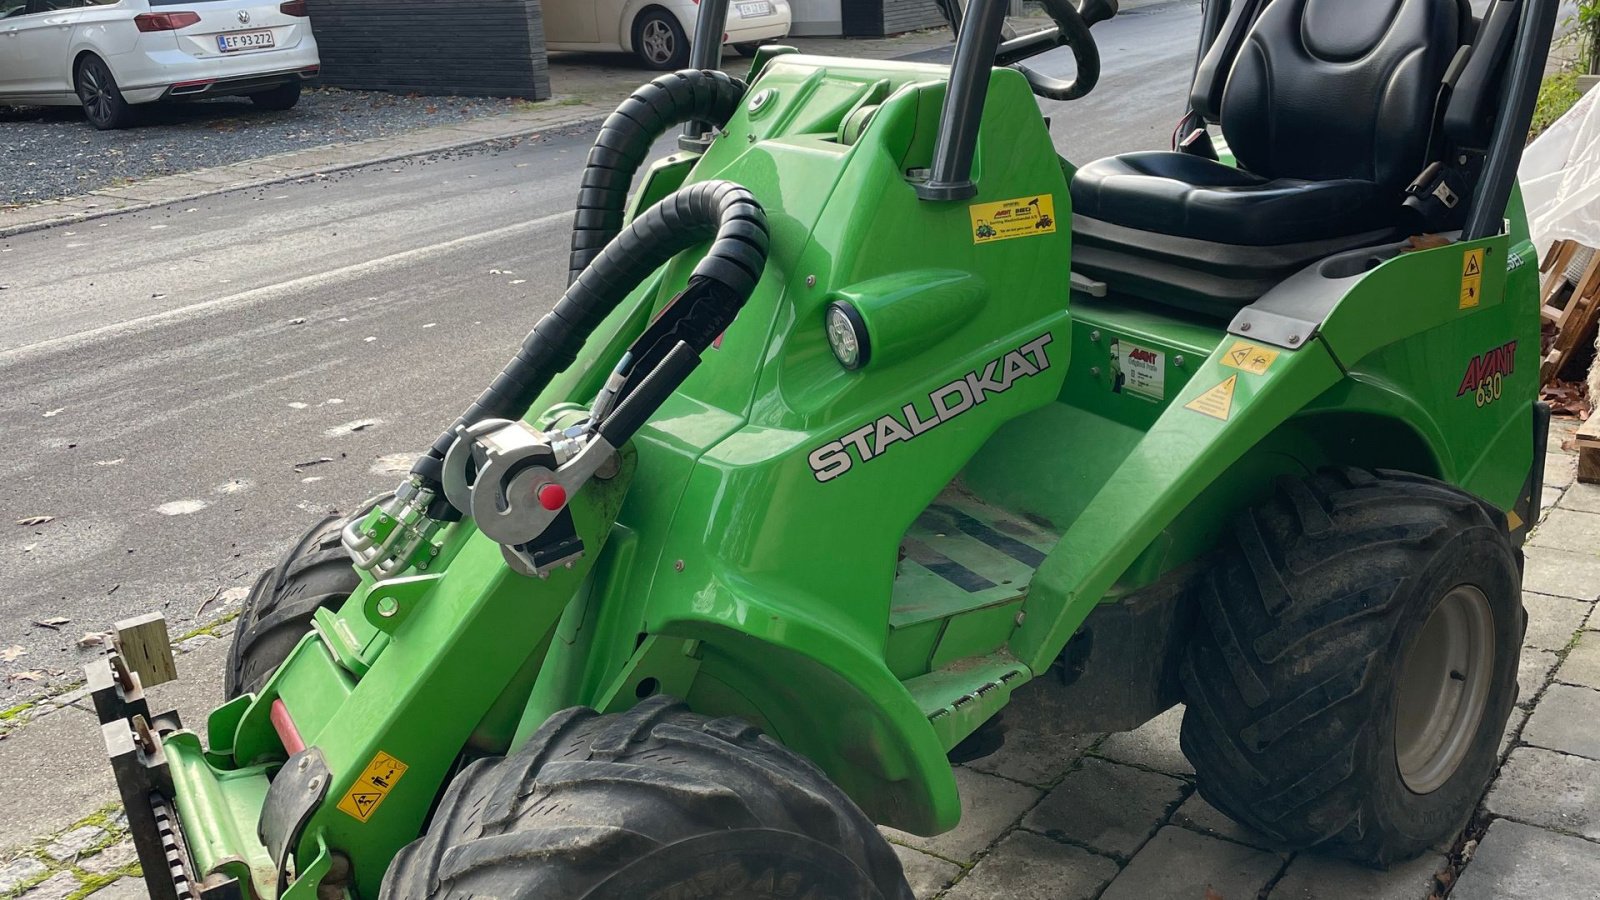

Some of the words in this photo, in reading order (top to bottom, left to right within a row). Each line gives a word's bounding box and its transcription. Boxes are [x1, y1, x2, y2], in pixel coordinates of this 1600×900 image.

[226, 36, 239, 47] EF
[240, 35, 253, 46] 93
[254, 33, 272, 45] 272
[1128, 348, 1158, 365] AVANT
[1456, 340, 1517, 397] AVANT
[808, 332, 1053, 483] STALDKAT
[1475, 371, 1503, 408] 630
